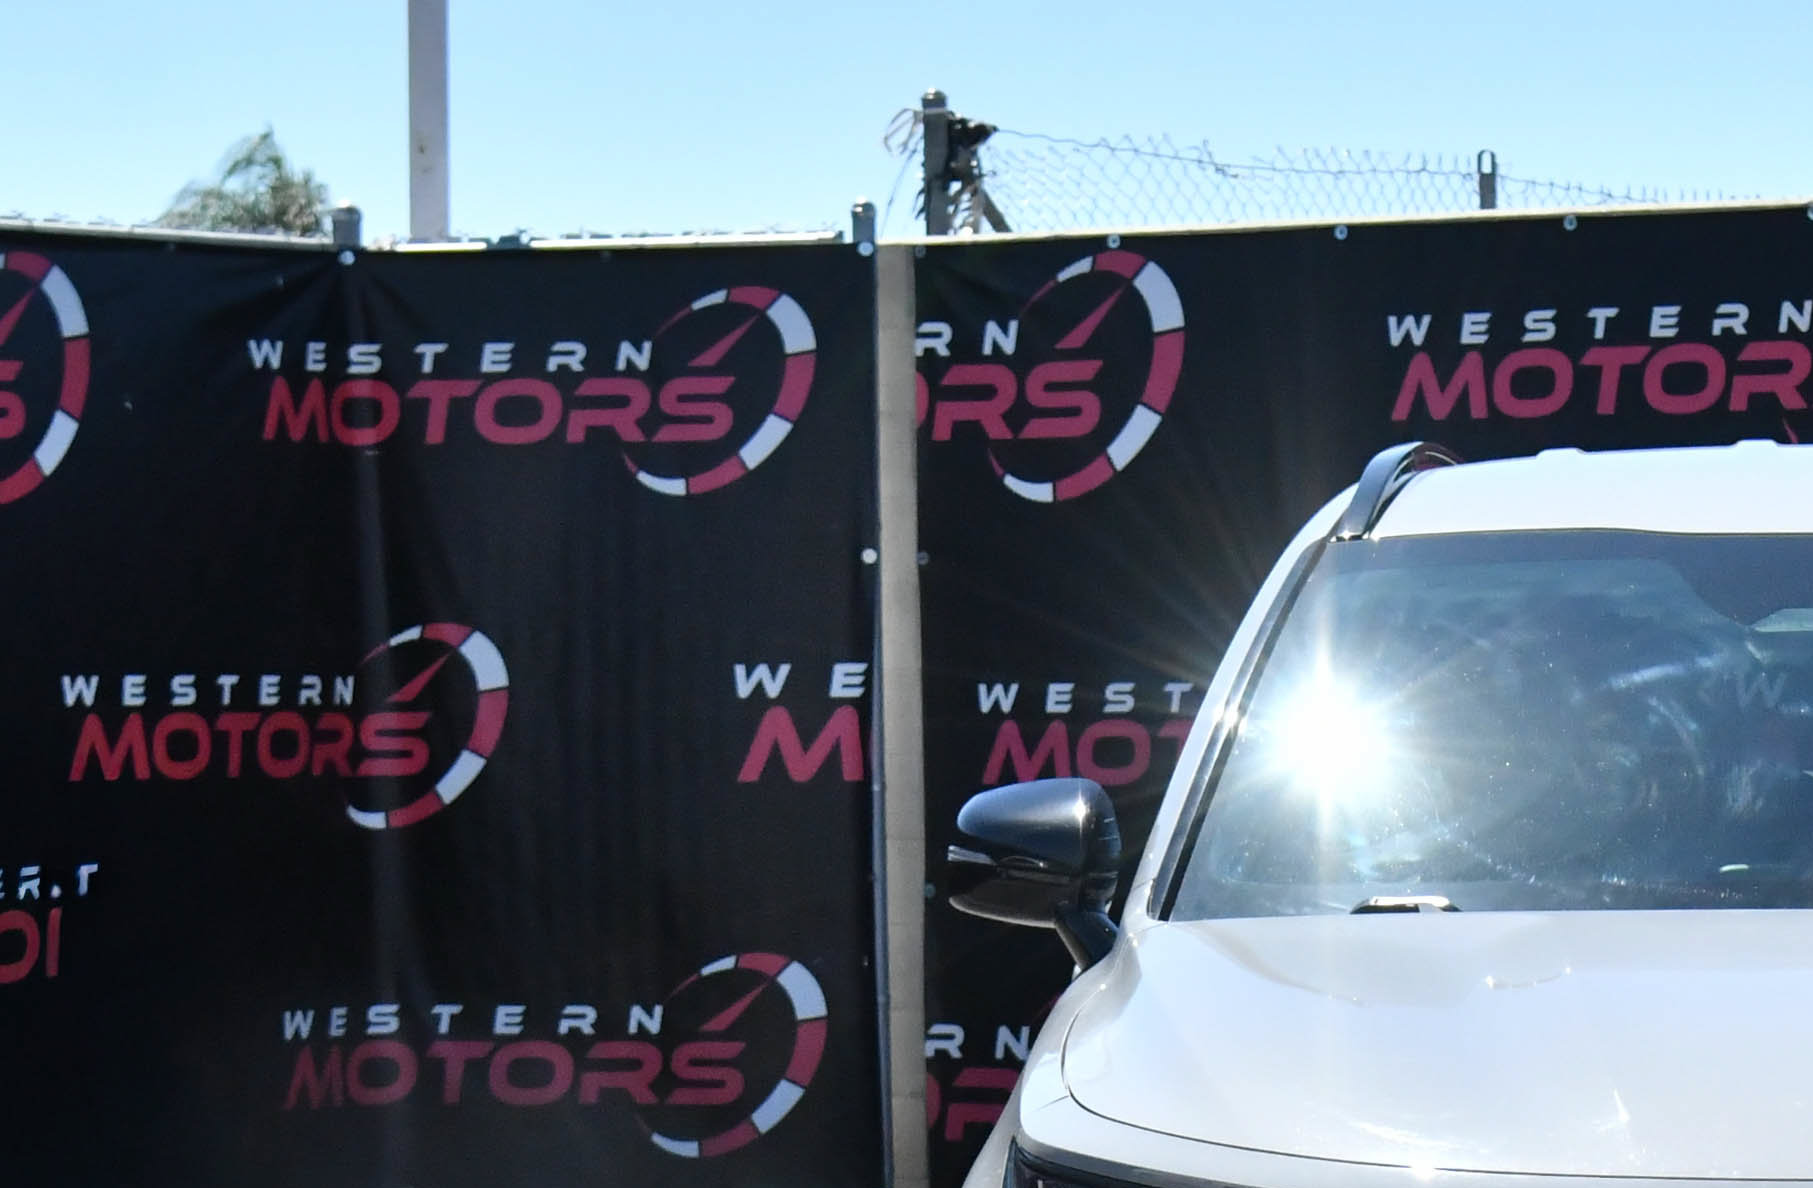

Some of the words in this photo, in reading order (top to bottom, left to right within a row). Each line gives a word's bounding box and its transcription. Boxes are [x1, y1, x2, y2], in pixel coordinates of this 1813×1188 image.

[1387, 300, 1813, 347] WESTERN
[248, 340, 652, 374] WESTERN
[263, 376, 736, 444] MOTORS
[915, 360, 1103, 441] RS
[62, 674, 355, 706] WESTERN
[734, 662, 868, 699] WE
[977, 682, 1194, 714] WEST
[69, 711, 431, 781] MOTORS
[283, 1004, 663, 1041] WESTERN
[284, 1041, 746, 1102] MOTORS
